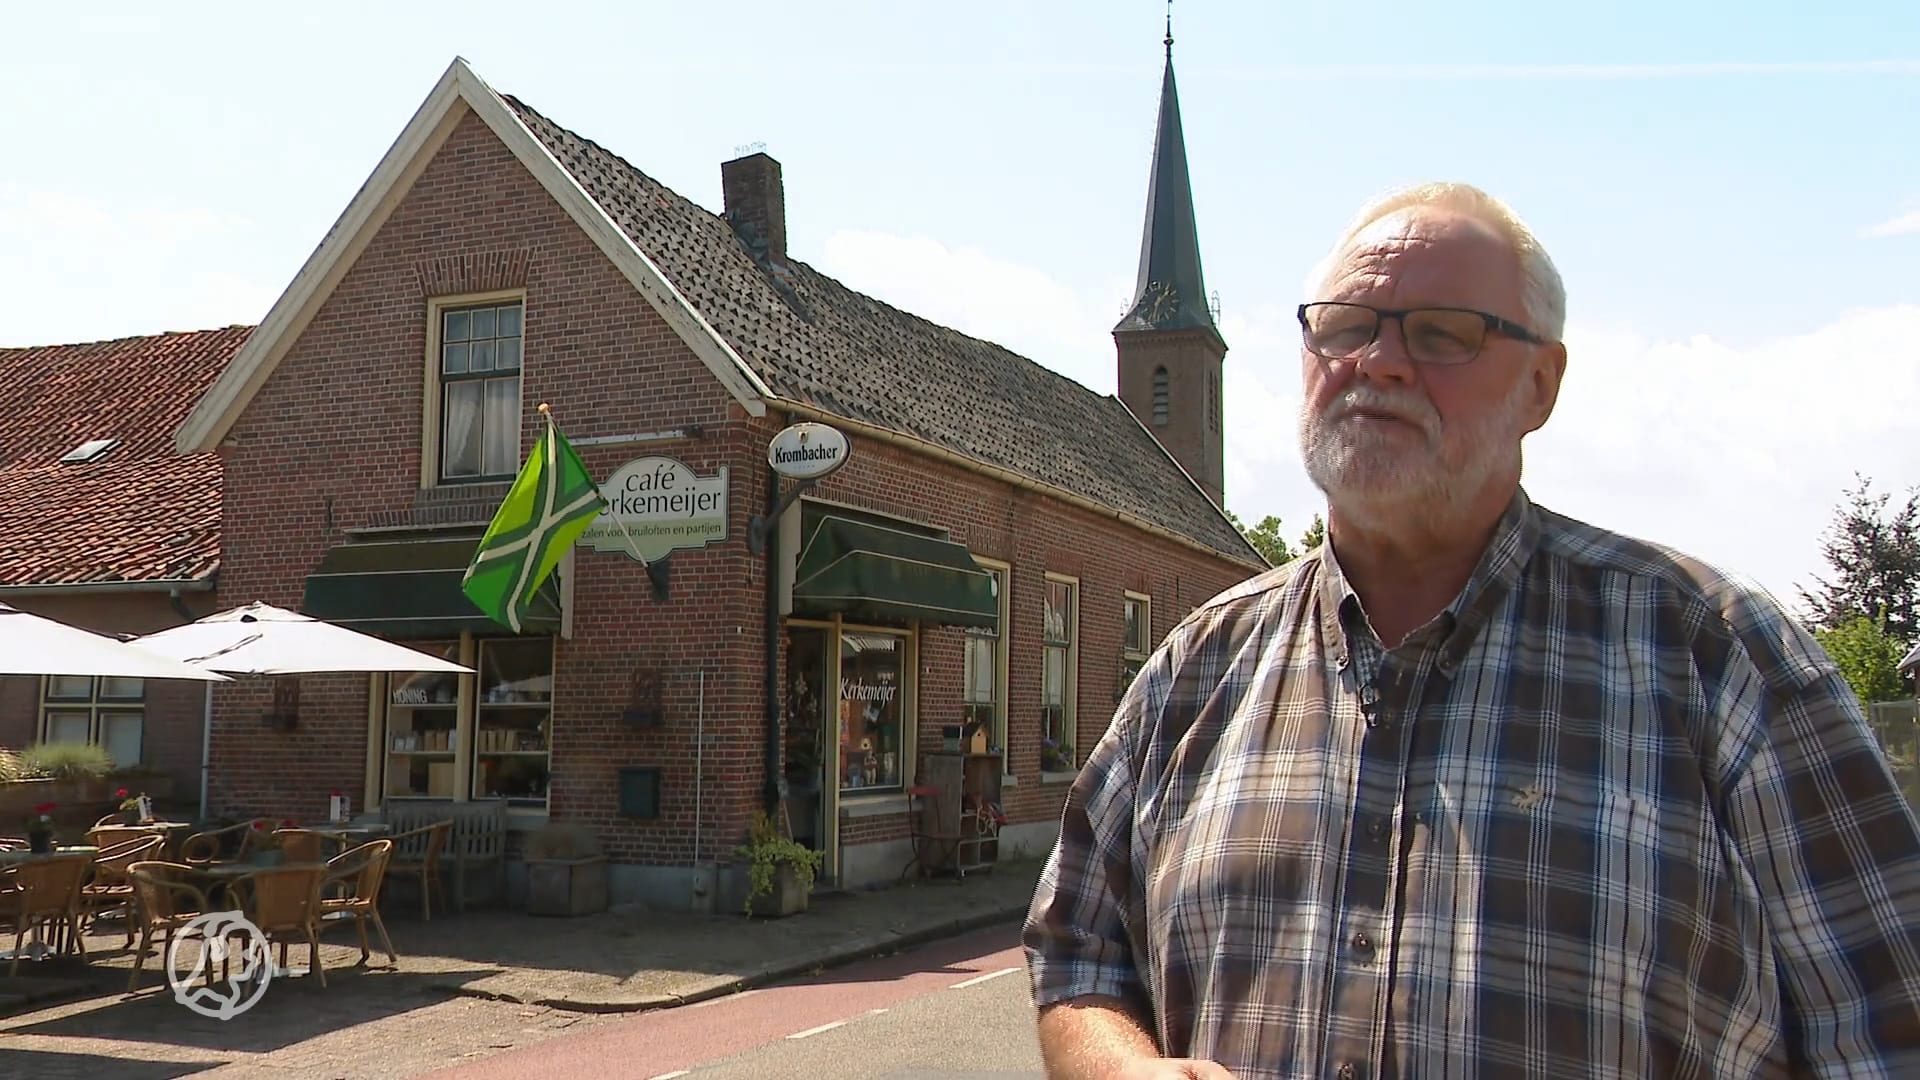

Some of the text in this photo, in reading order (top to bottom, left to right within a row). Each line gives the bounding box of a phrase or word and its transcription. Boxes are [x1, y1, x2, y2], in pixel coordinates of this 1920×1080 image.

[775, 442, 838, 464] Krombacher
[626, 464, 676, 492] café
[598, 486, 721, 518] rkemeijer
[628, 524, 671, 537] bruiloften
[672, 526, 684, 535] en
[686, 523, 721, 537] partijen
[392, 688, 428, 704] HONING
[840, 677, 896, 710] Kerkemeijer
